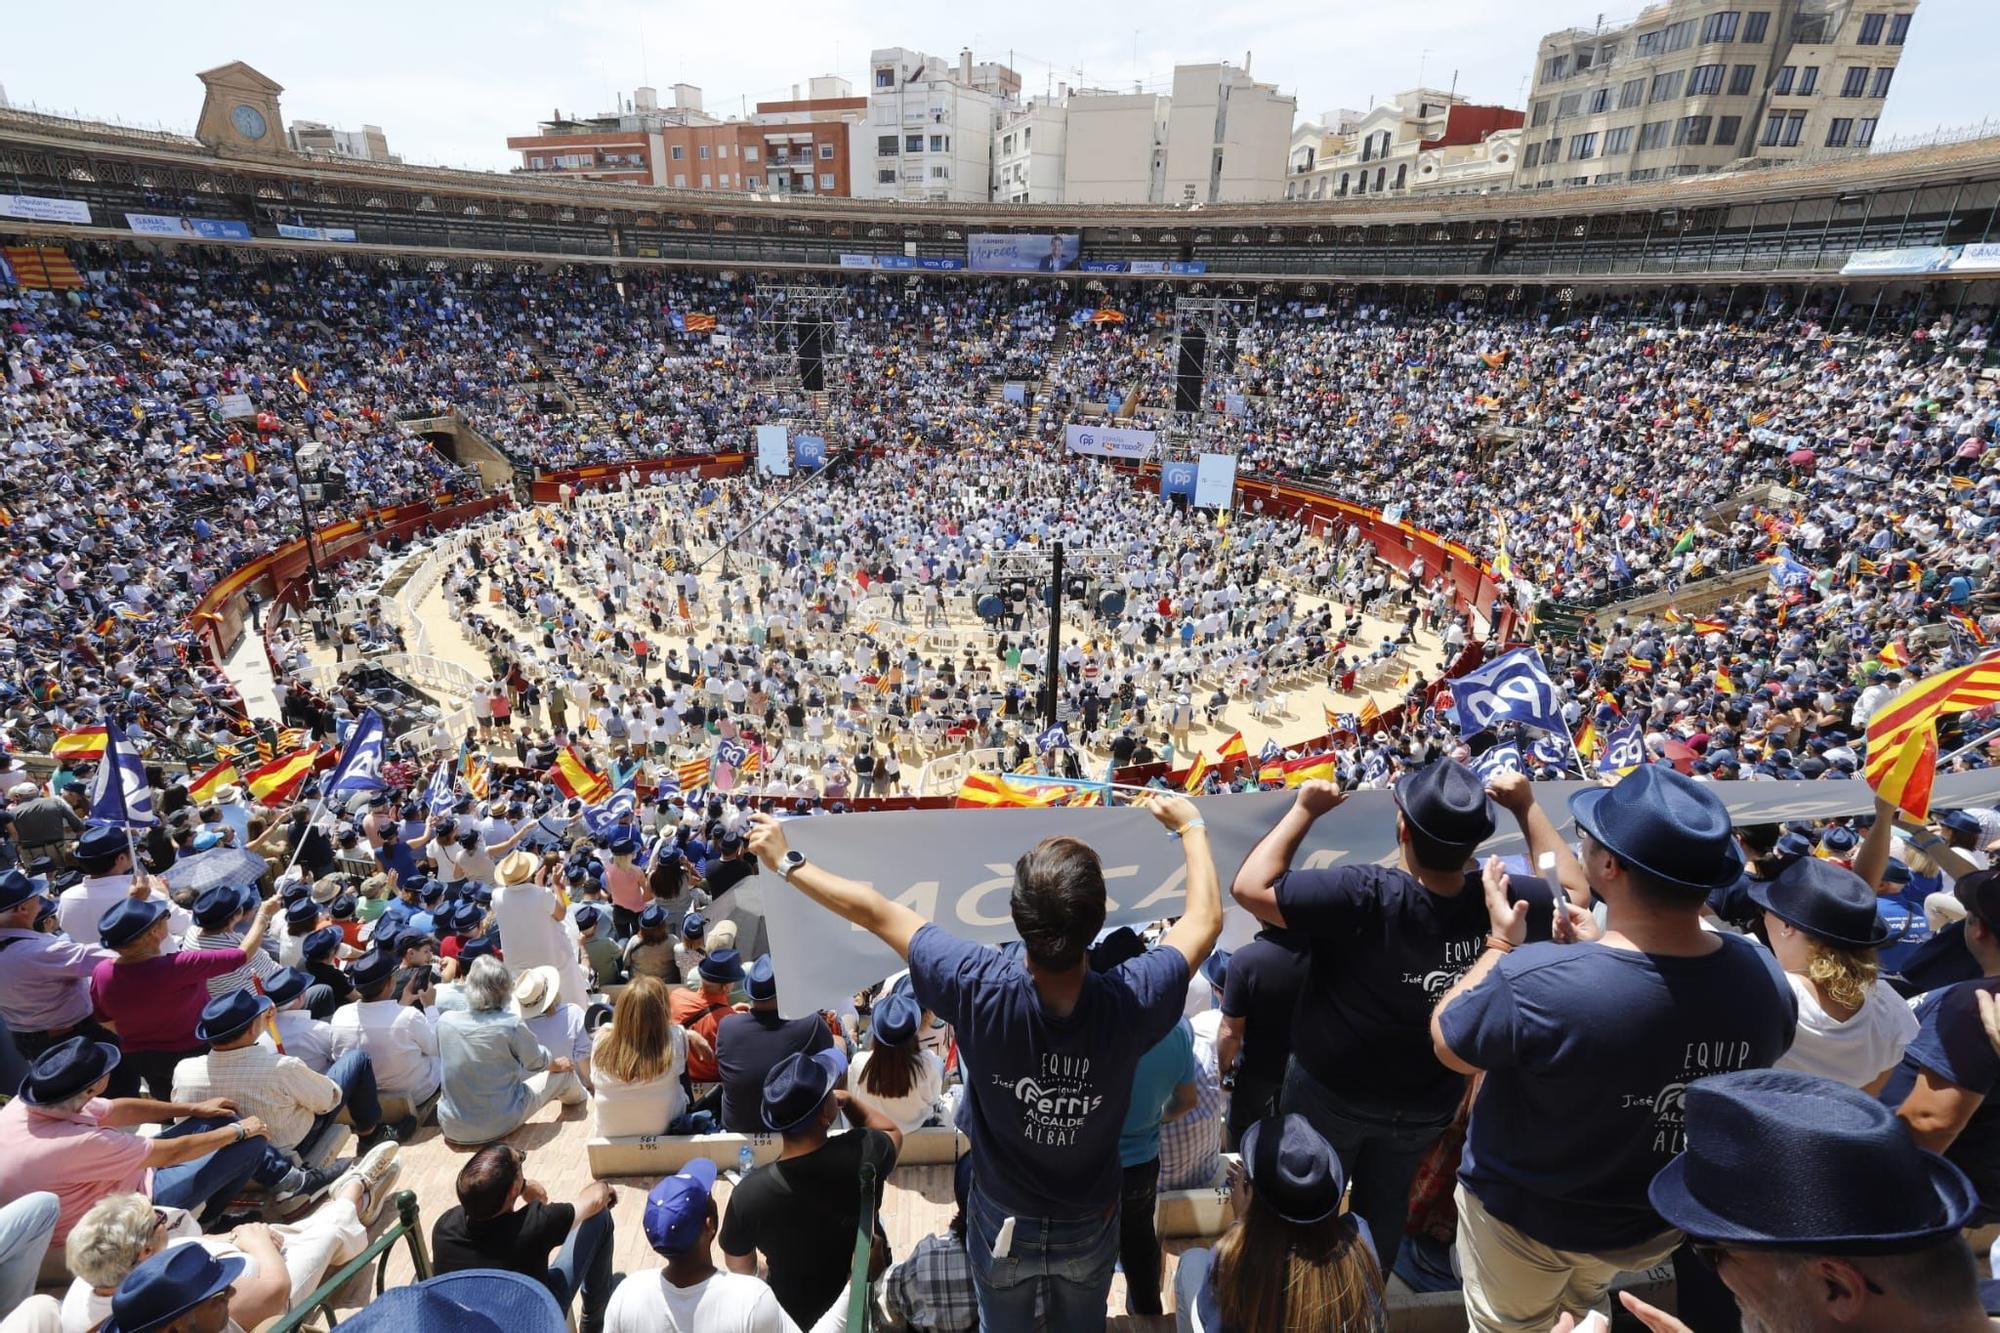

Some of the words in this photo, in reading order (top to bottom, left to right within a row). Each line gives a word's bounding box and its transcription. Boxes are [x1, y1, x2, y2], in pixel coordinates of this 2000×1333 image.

[1041, 1053, 1090, 1079] EQUIP
[1684, 1041, 1750, 1069] EQUIP
[991, 1074, 1015, 1088] José
[1024, 1086, 1103, 1115] Ferris
[1621, 1095, 1655, 1109] José
[1026, 1108, 1086, 1127] ALCALDE
[1024, 1123, 1076, 1146] ALBAL
